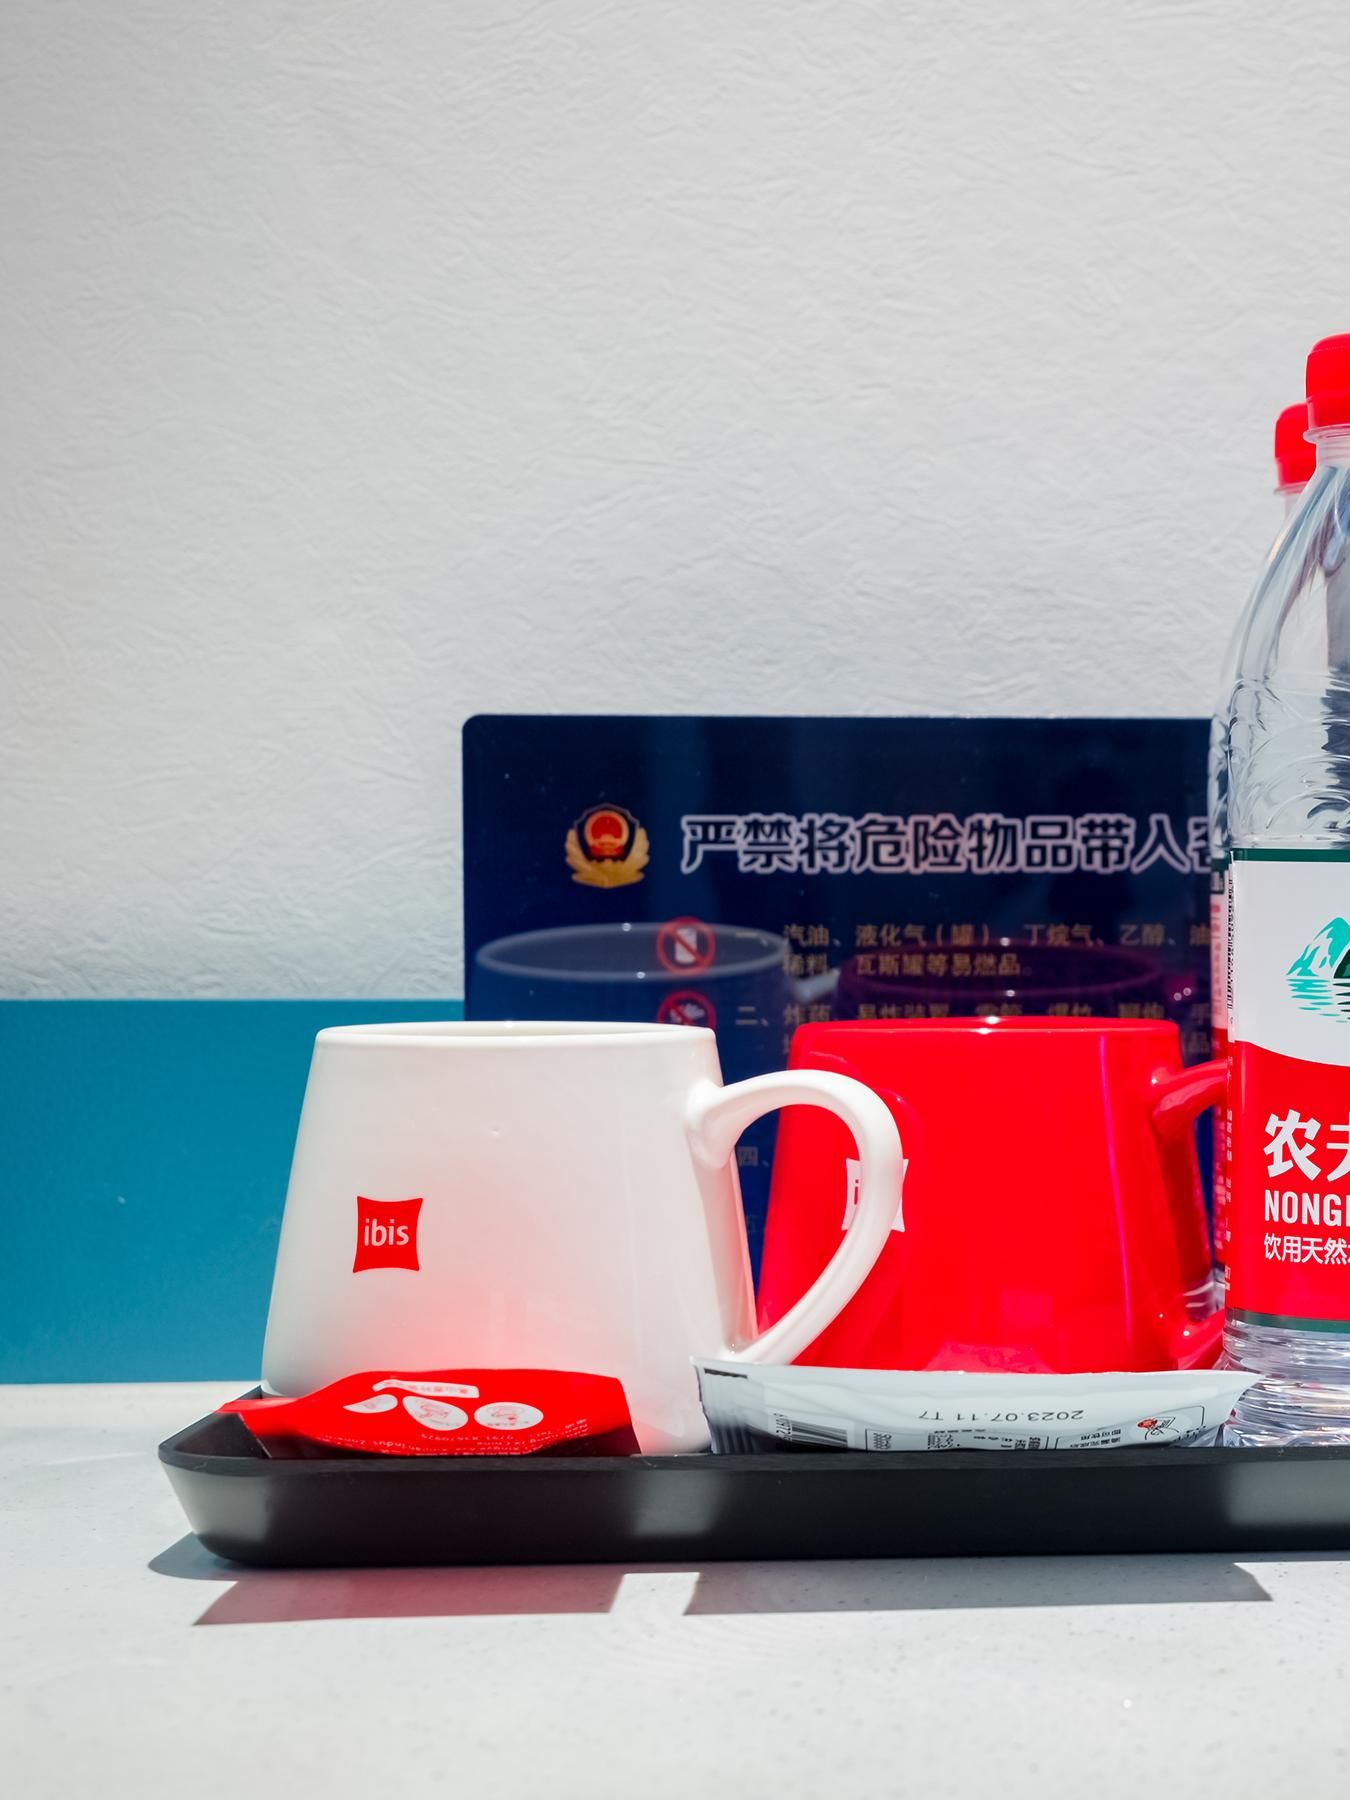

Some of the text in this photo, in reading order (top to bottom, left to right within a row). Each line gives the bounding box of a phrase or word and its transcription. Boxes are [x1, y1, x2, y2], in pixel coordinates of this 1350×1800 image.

[364, 1218, 409, 1246] ibis
[919, 1409, 1084, 1421] 2023.07.11 T7
